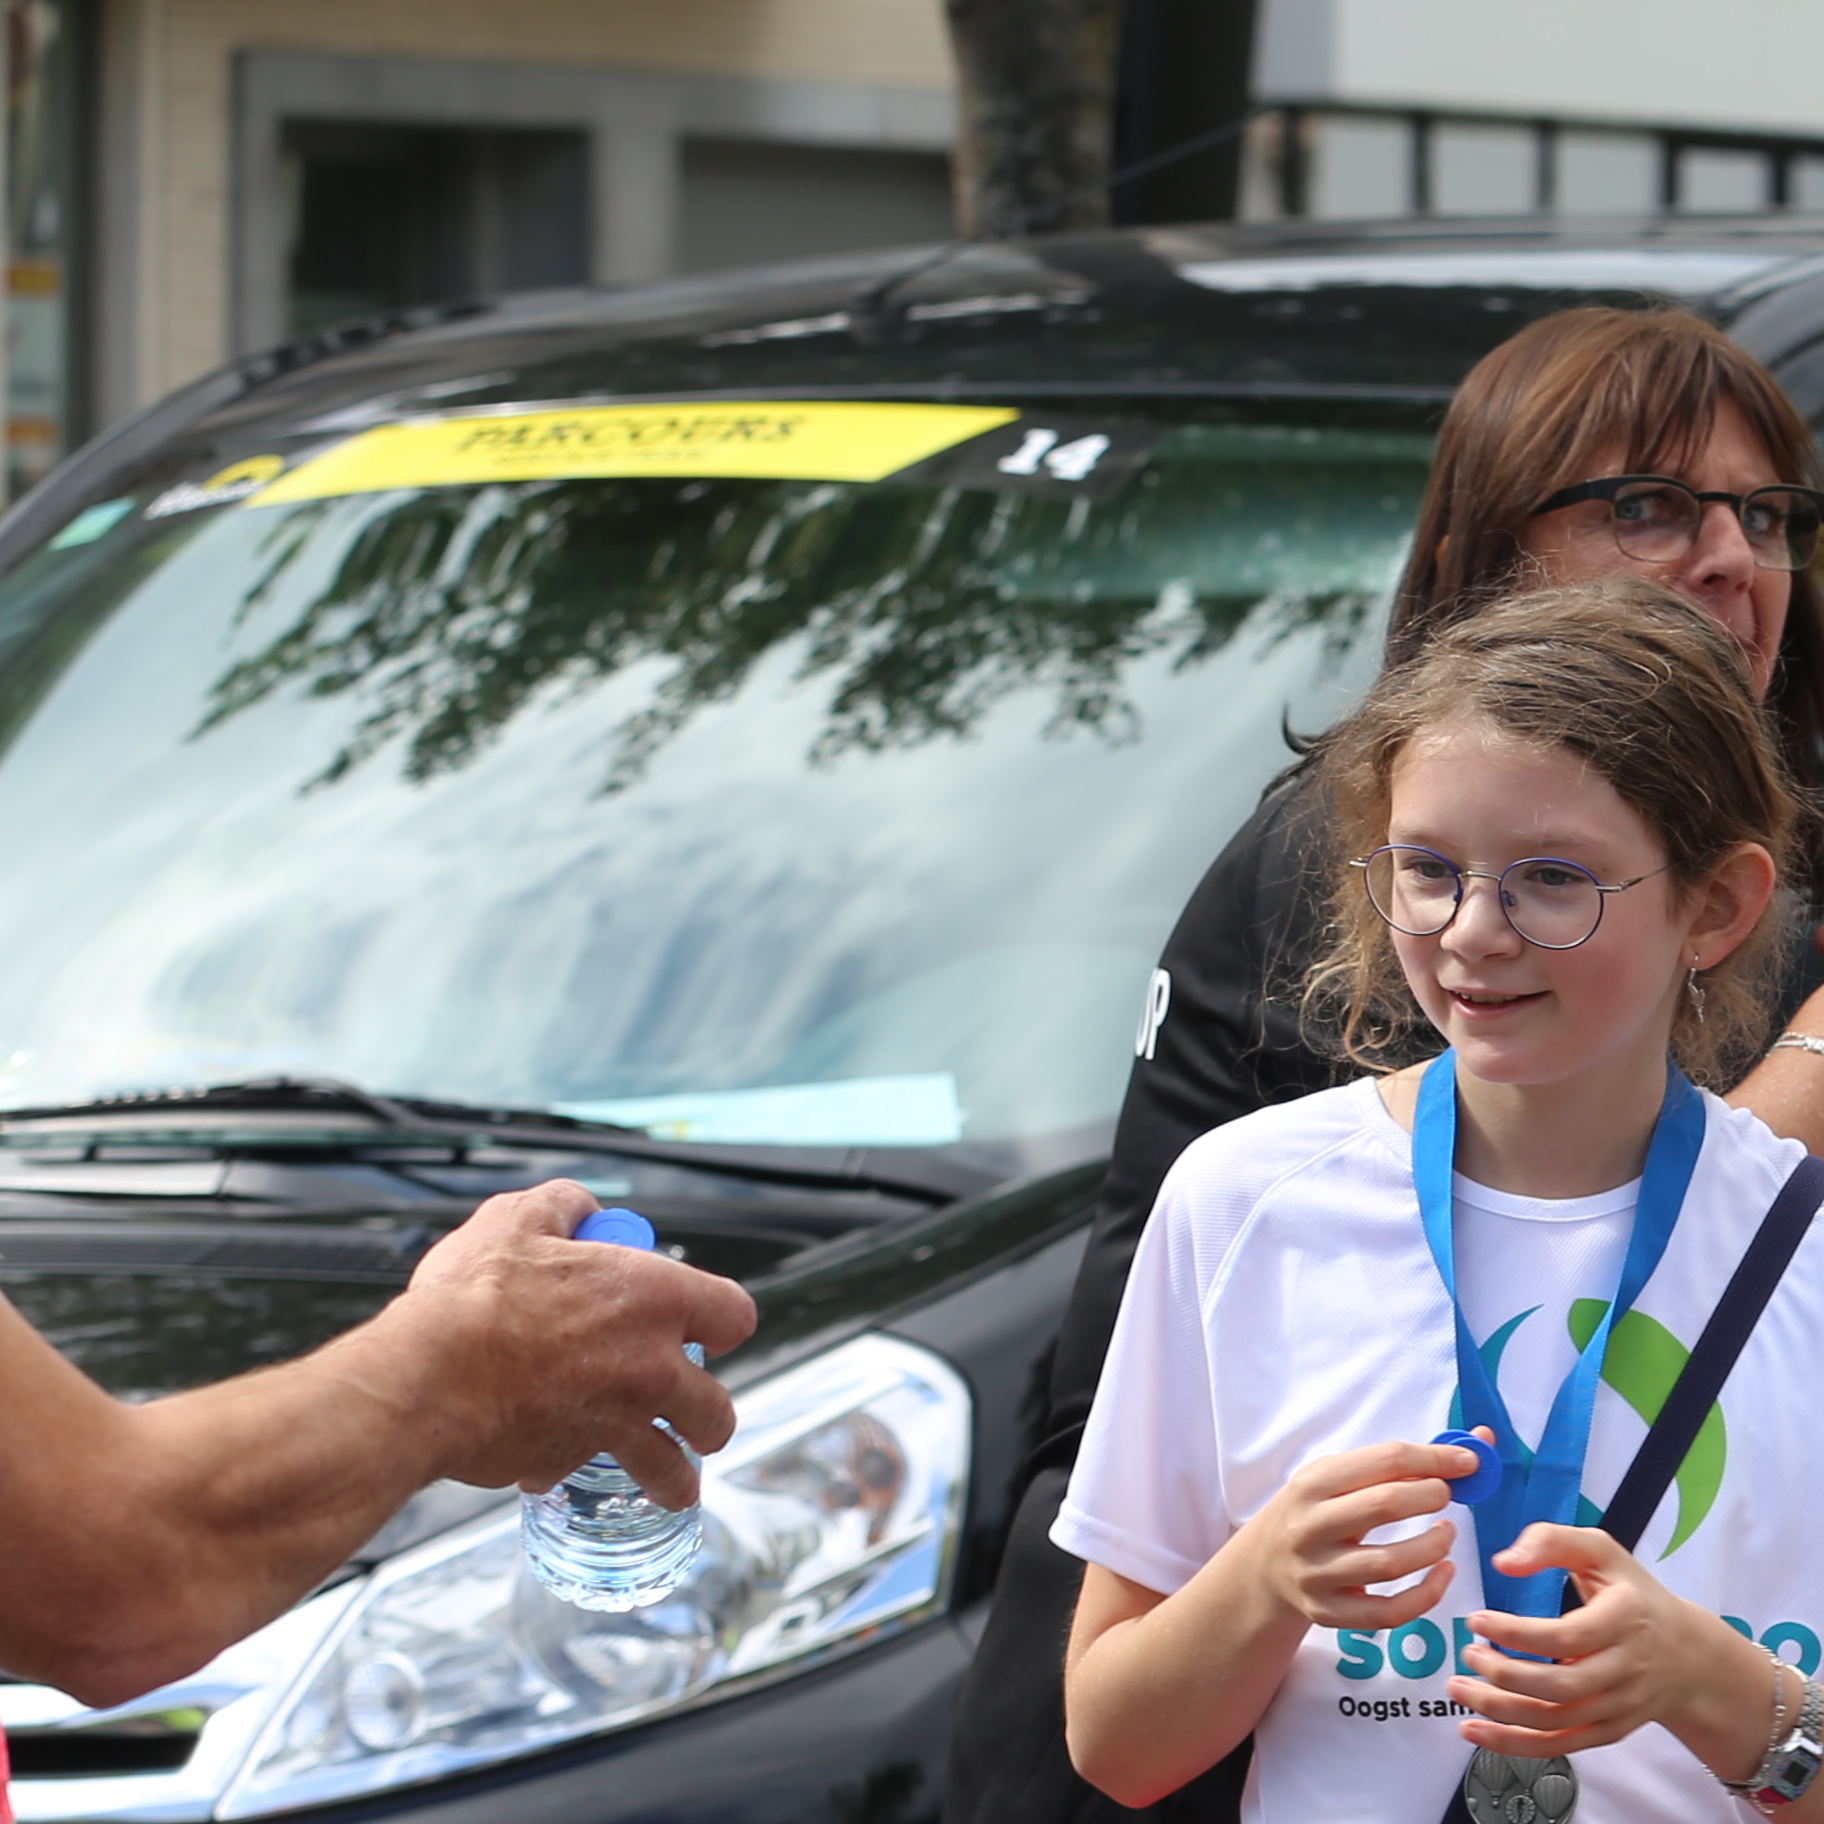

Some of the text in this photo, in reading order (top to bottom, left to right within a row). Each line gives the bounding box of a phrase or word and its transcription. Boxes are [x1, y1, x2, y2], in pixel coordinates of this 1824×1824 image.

[452, 414, 804, 453] PARCOURS
[998, 428, 1110, 482] 14
[1339, 1696, 1411, 1722] Oogst
